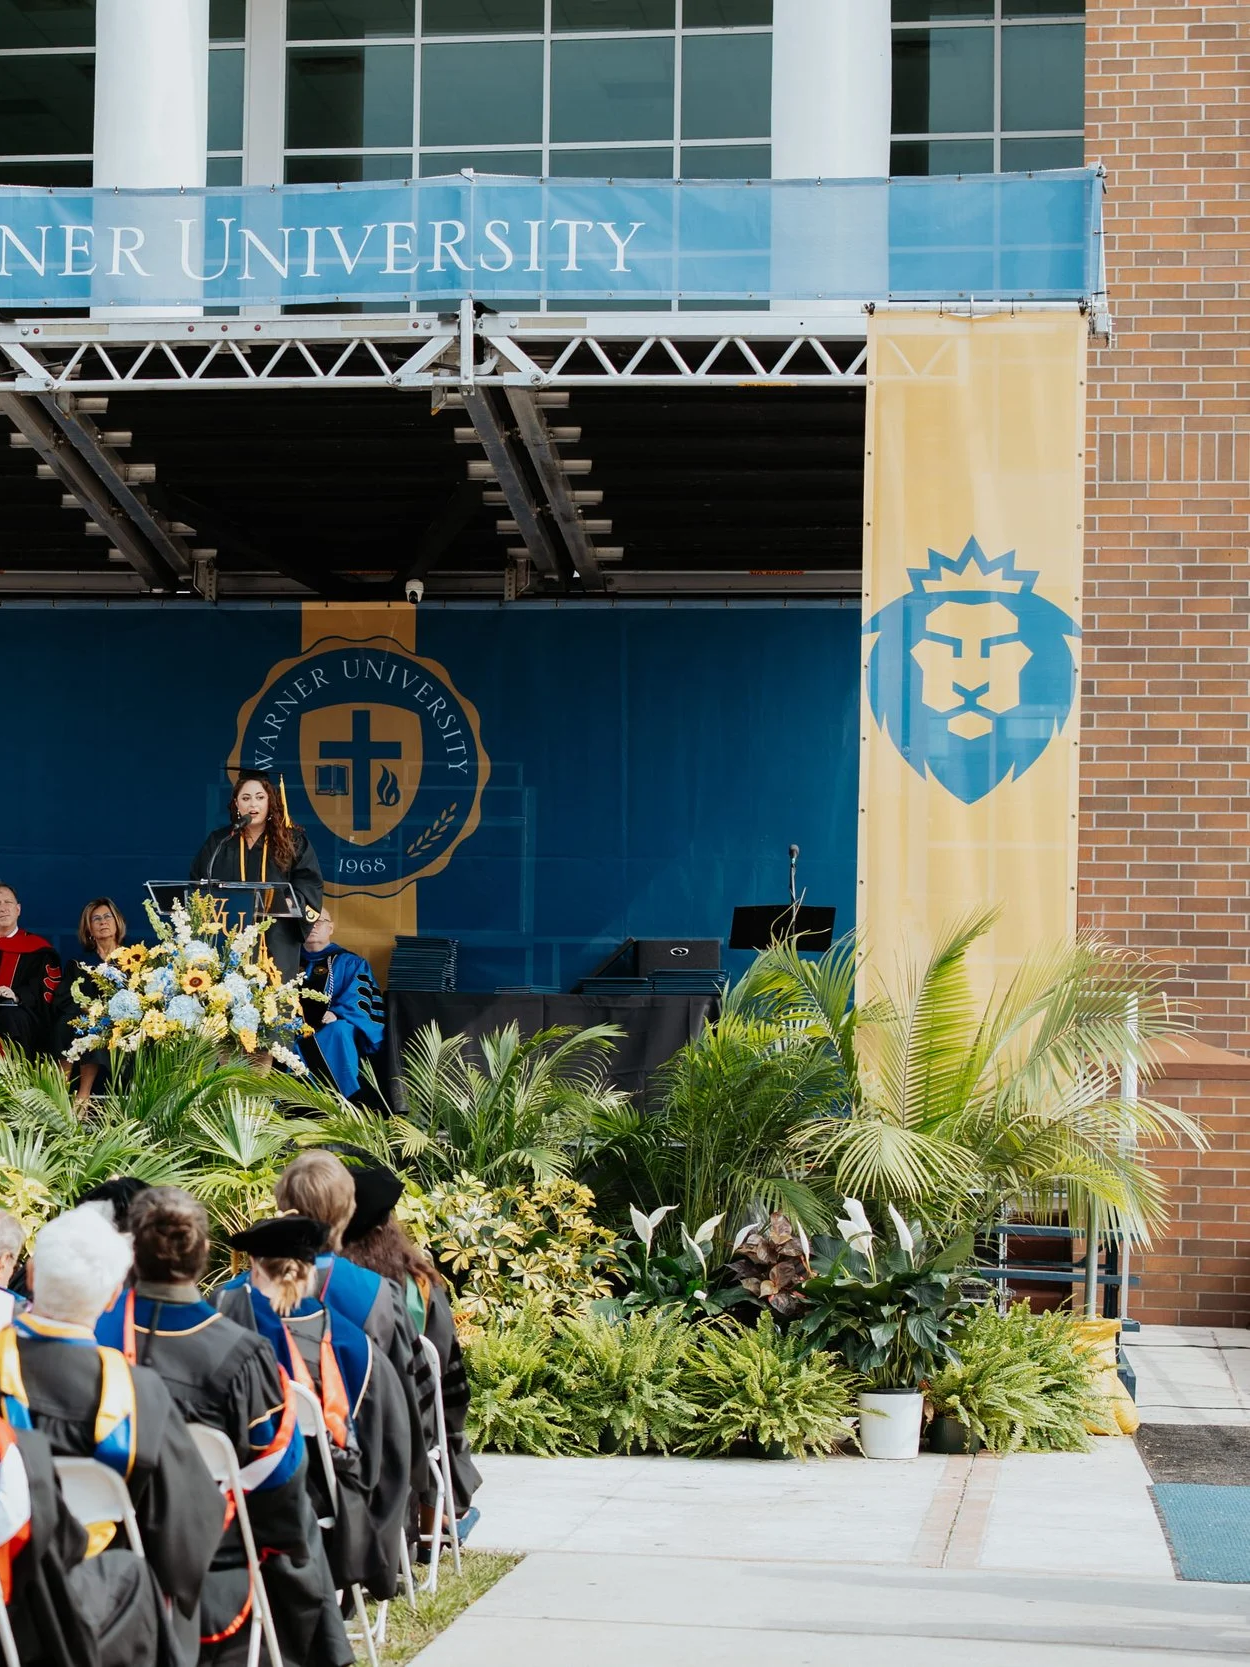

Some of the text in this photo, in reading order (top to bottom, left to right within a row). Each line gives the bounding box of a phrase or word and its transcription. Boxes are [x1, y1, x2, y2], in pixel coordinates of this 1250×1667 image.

[175, 217, 645, 281] UNIVERSITY
[254, 659, 468, 774] WARNER UNIVERSITY
[338, 857, 386, 874] 1968
